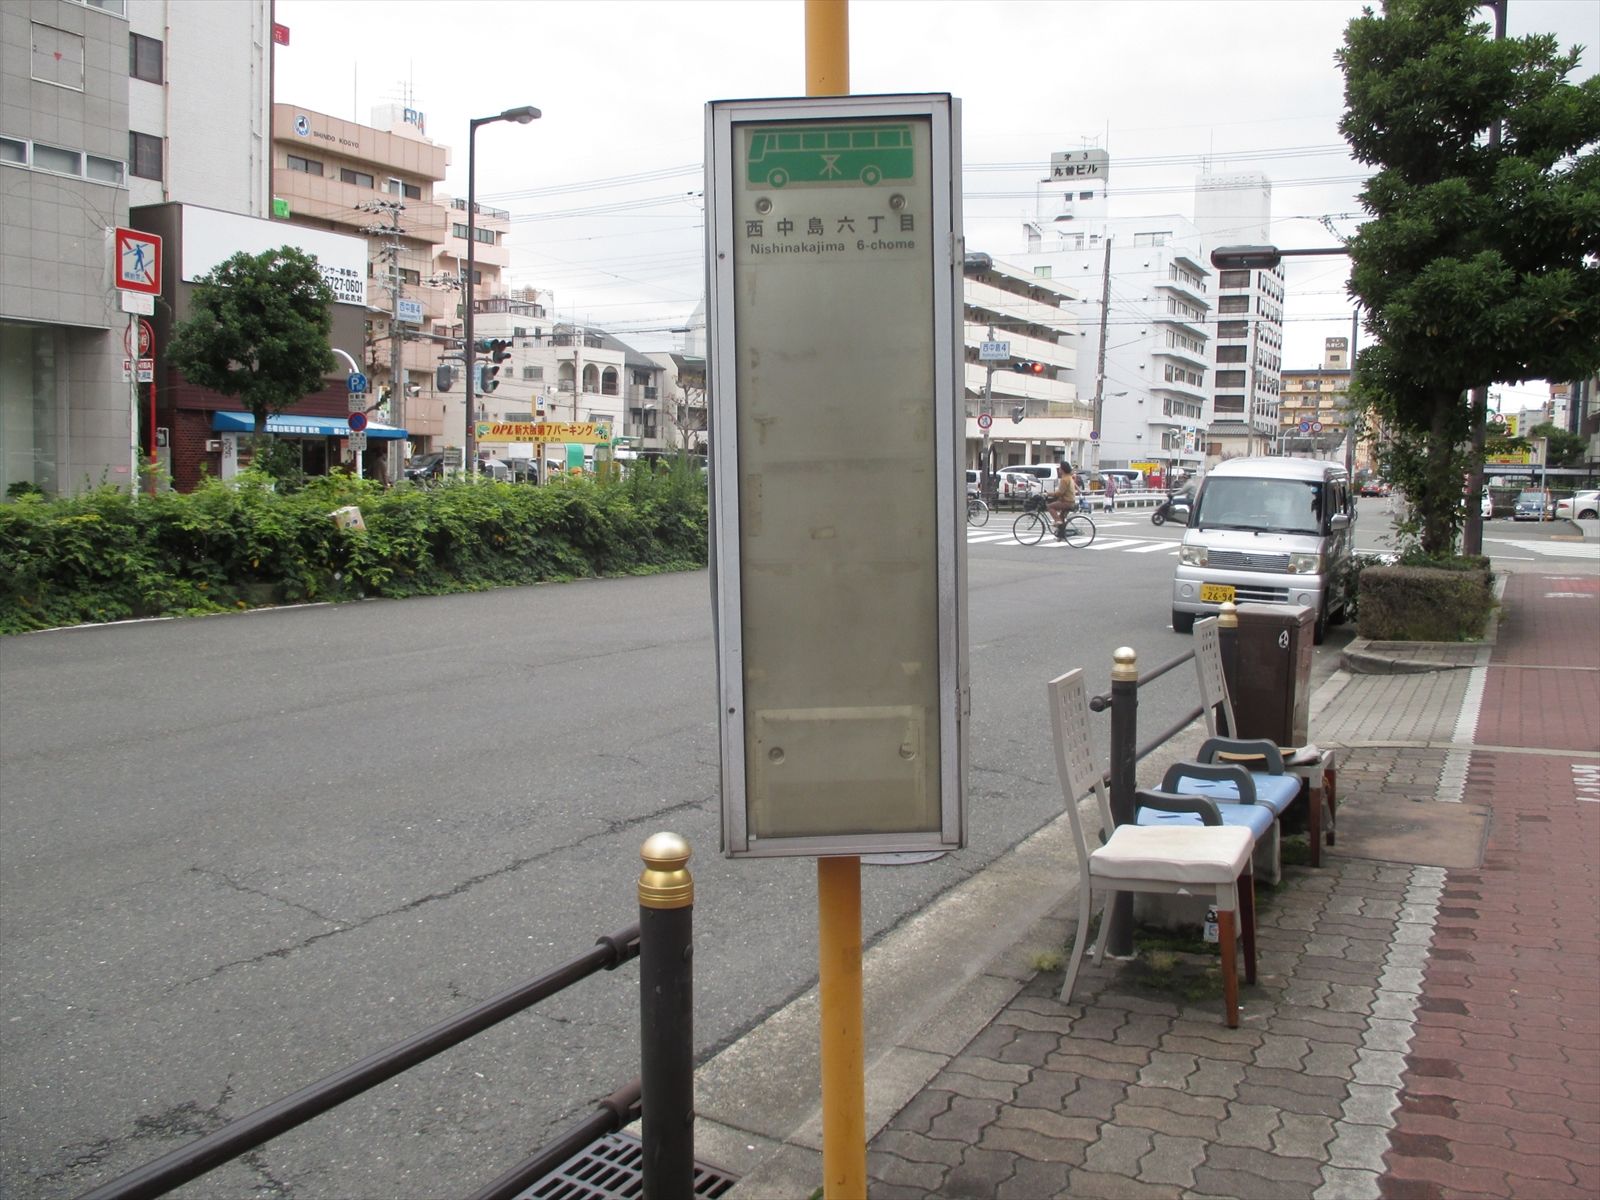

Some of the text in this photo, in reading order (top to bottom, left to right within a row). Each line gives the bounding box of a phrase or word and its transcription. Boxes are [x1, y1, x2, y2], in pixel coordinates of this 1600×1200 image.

[745, 214, 914, 238] 西中島六丁目
[750, 239, 915, 255] Nishinakajima 6-chome
[324, 275, 363, 294] 6727-0601
[491, 424, 514, 435] OPL
